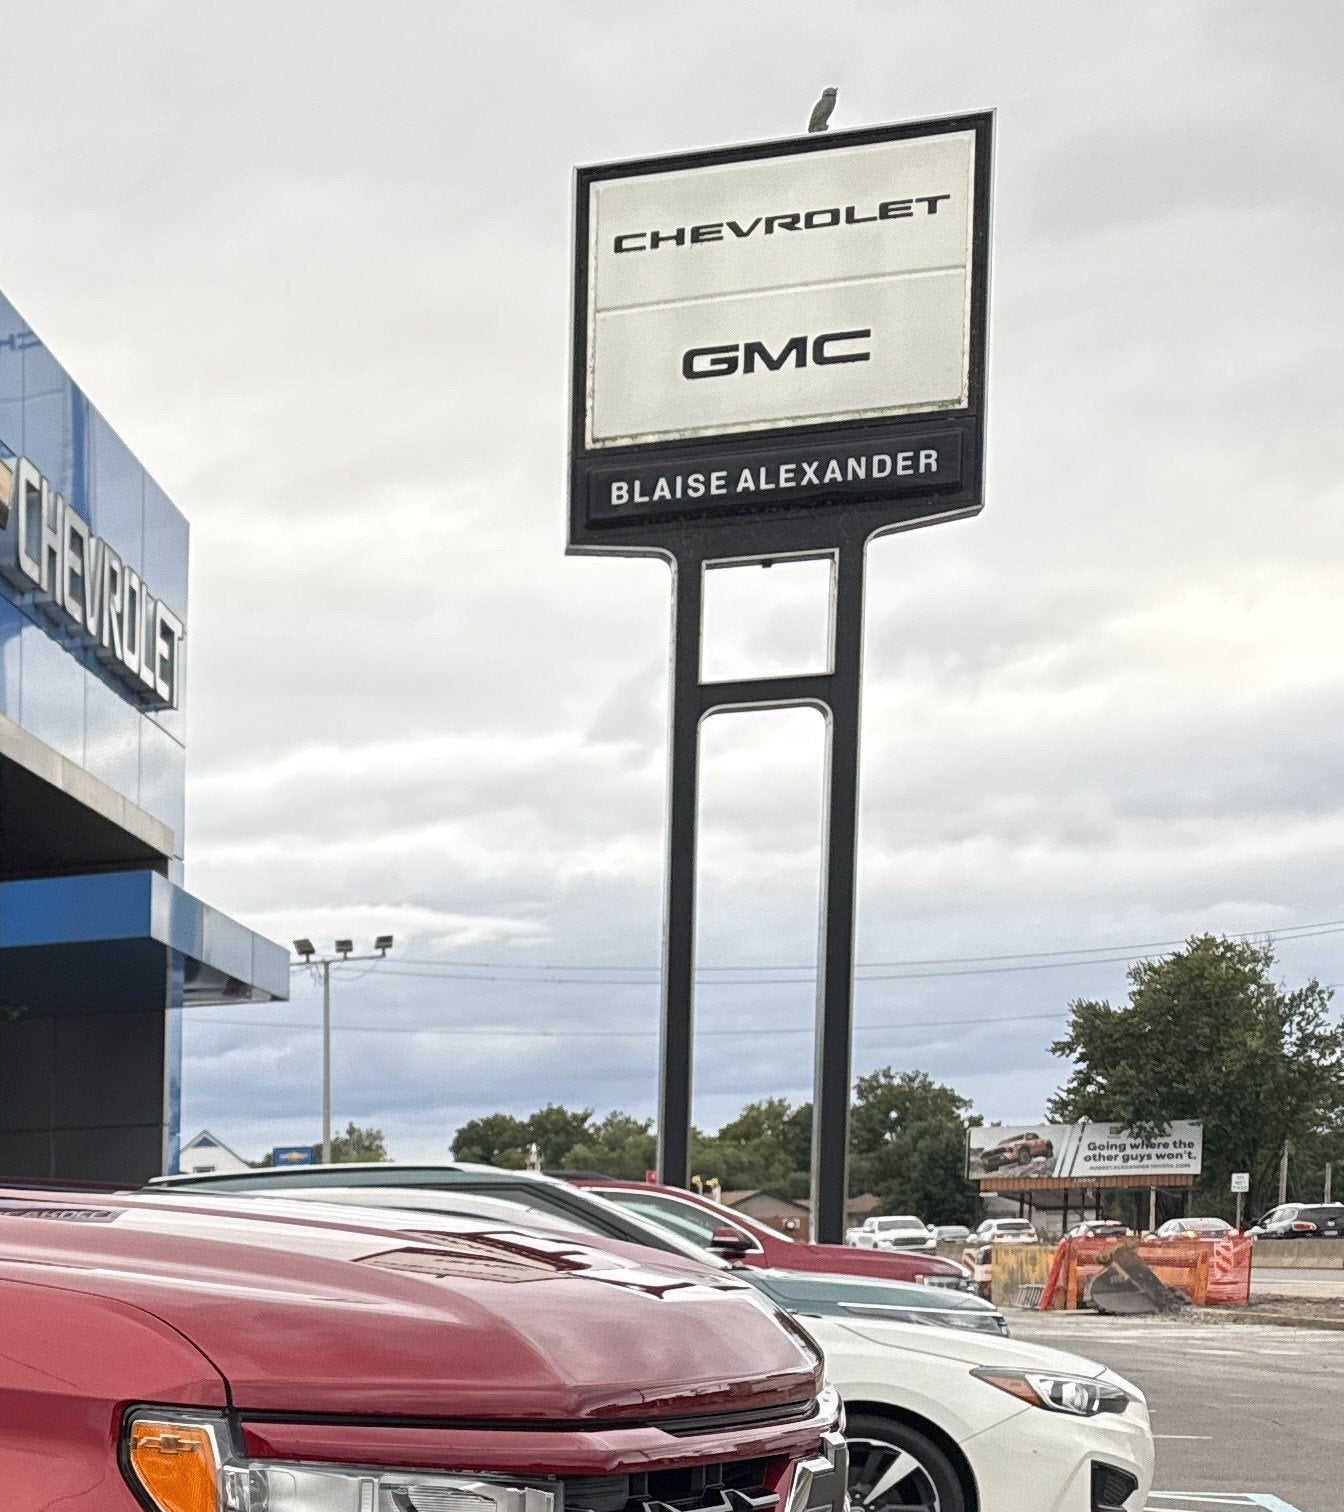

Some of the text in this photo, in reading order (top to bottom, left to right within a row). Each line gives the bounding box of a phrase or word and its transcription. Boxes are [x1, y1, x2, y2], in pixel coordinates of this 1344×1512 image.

[612, 193, 952, 255] CHEVROLET
[681, 328, 873, 381] GMC
[610, 448, 940, 507] BLAISE ALEXANDER
[4, 454, 187, 711] CHEVROLET
[1083, 1152, 1119, 1162] other
[1121, 1153, 1152, 1163] guys
[1087, 1139, 1195, 1152] Going where the
